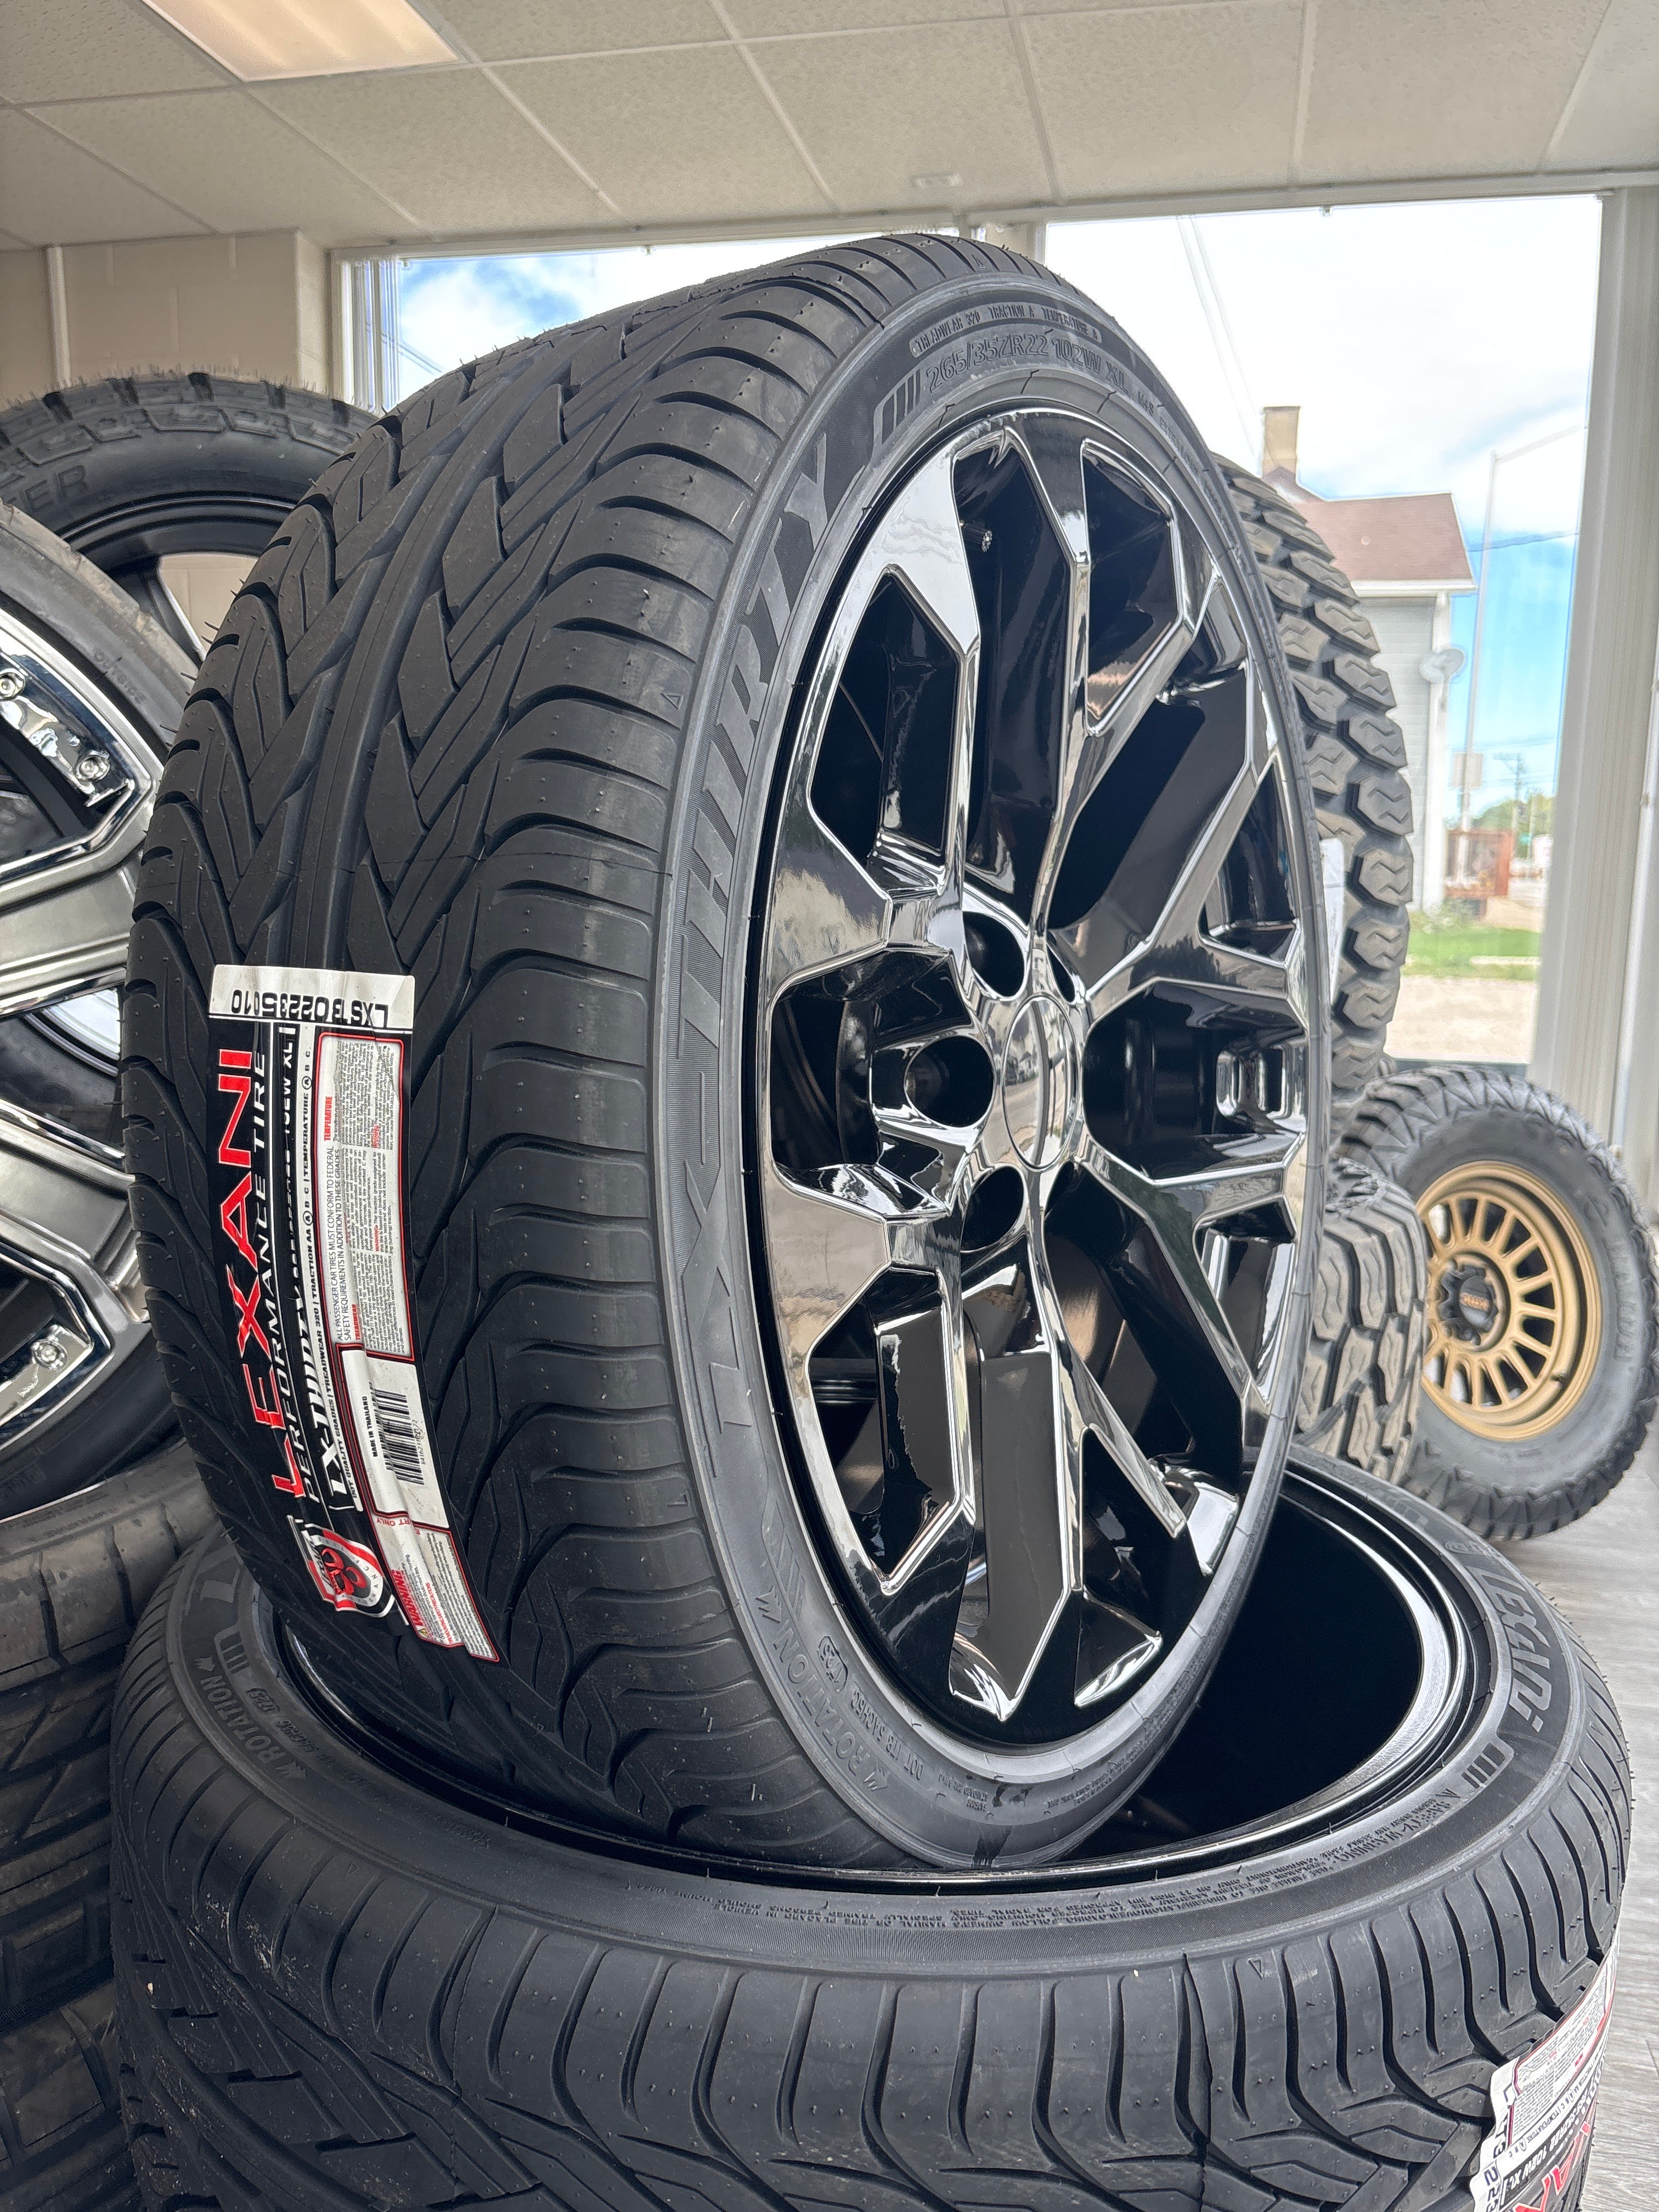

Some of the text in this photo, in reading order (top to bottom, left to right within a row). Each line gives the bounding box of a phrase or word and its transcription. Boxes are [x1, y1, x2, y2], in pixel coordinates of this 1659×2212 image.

[988, 305, 1025, 319] TRACTION
[1030, 306, 1035, 317] A
[926, 334, 1049, 393] 265/35ZR22
[1052, 338, 1101, 374] 102W
[1106, 361, 1128, 394] XL
[253, 1049, 266, 1152] TIRE
[324, 1096, 332, 1141] TEMPERATURE
[327, 1179, 334, 1188] TO
[326, 1190, 335, 1227] CONFORM
[335, 1203, 342, 1212] TO
[217, 1048, 306, 1497] LEXANI
[306, 1244, 318, 1298] TRACTION
[337, 1259, 348, 1313] REQUIREMENTS
[332, 1286, 341, 1326] PASSENGER
[342, 1314, 351, 1340] SAFETY
[253, 1173, 320, 1502] PERFORMANCE
[317, 1329, 331, 1391] TREADWEAR
[328, 1398, 340, 1436] GRADES
[362, 1395, 372, 1429] THAILAND
[337, 1438, 352, 1477] QUALITY
[375, 1516, 395, 1526] ONLY
[391, 1569, 424, 1626] WARNING
[200, 1675, 285, 1763] ROTATION
[772, 1627, 870, 1776] ROTATION
